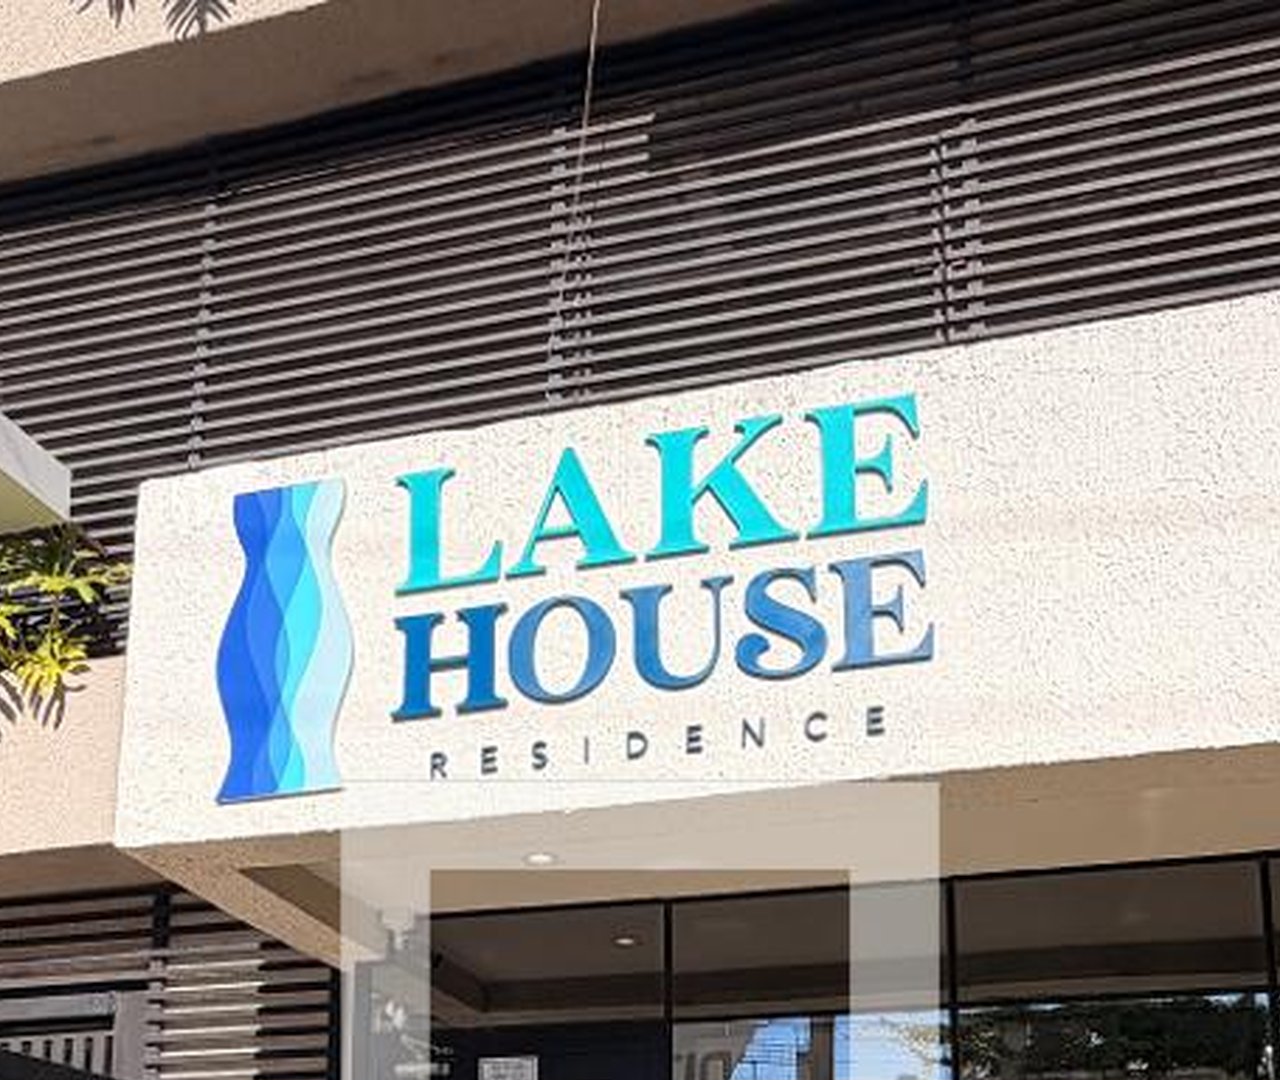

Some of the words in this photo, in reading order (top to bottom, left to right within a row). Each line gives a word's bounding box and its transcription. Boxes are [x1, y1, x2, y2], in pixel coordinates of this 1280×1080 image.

[396, 392, 930, 597] LAKE
[391, 549, 935, 723] HOUSE
[430, 706, 885, 779] RESIDENCE
